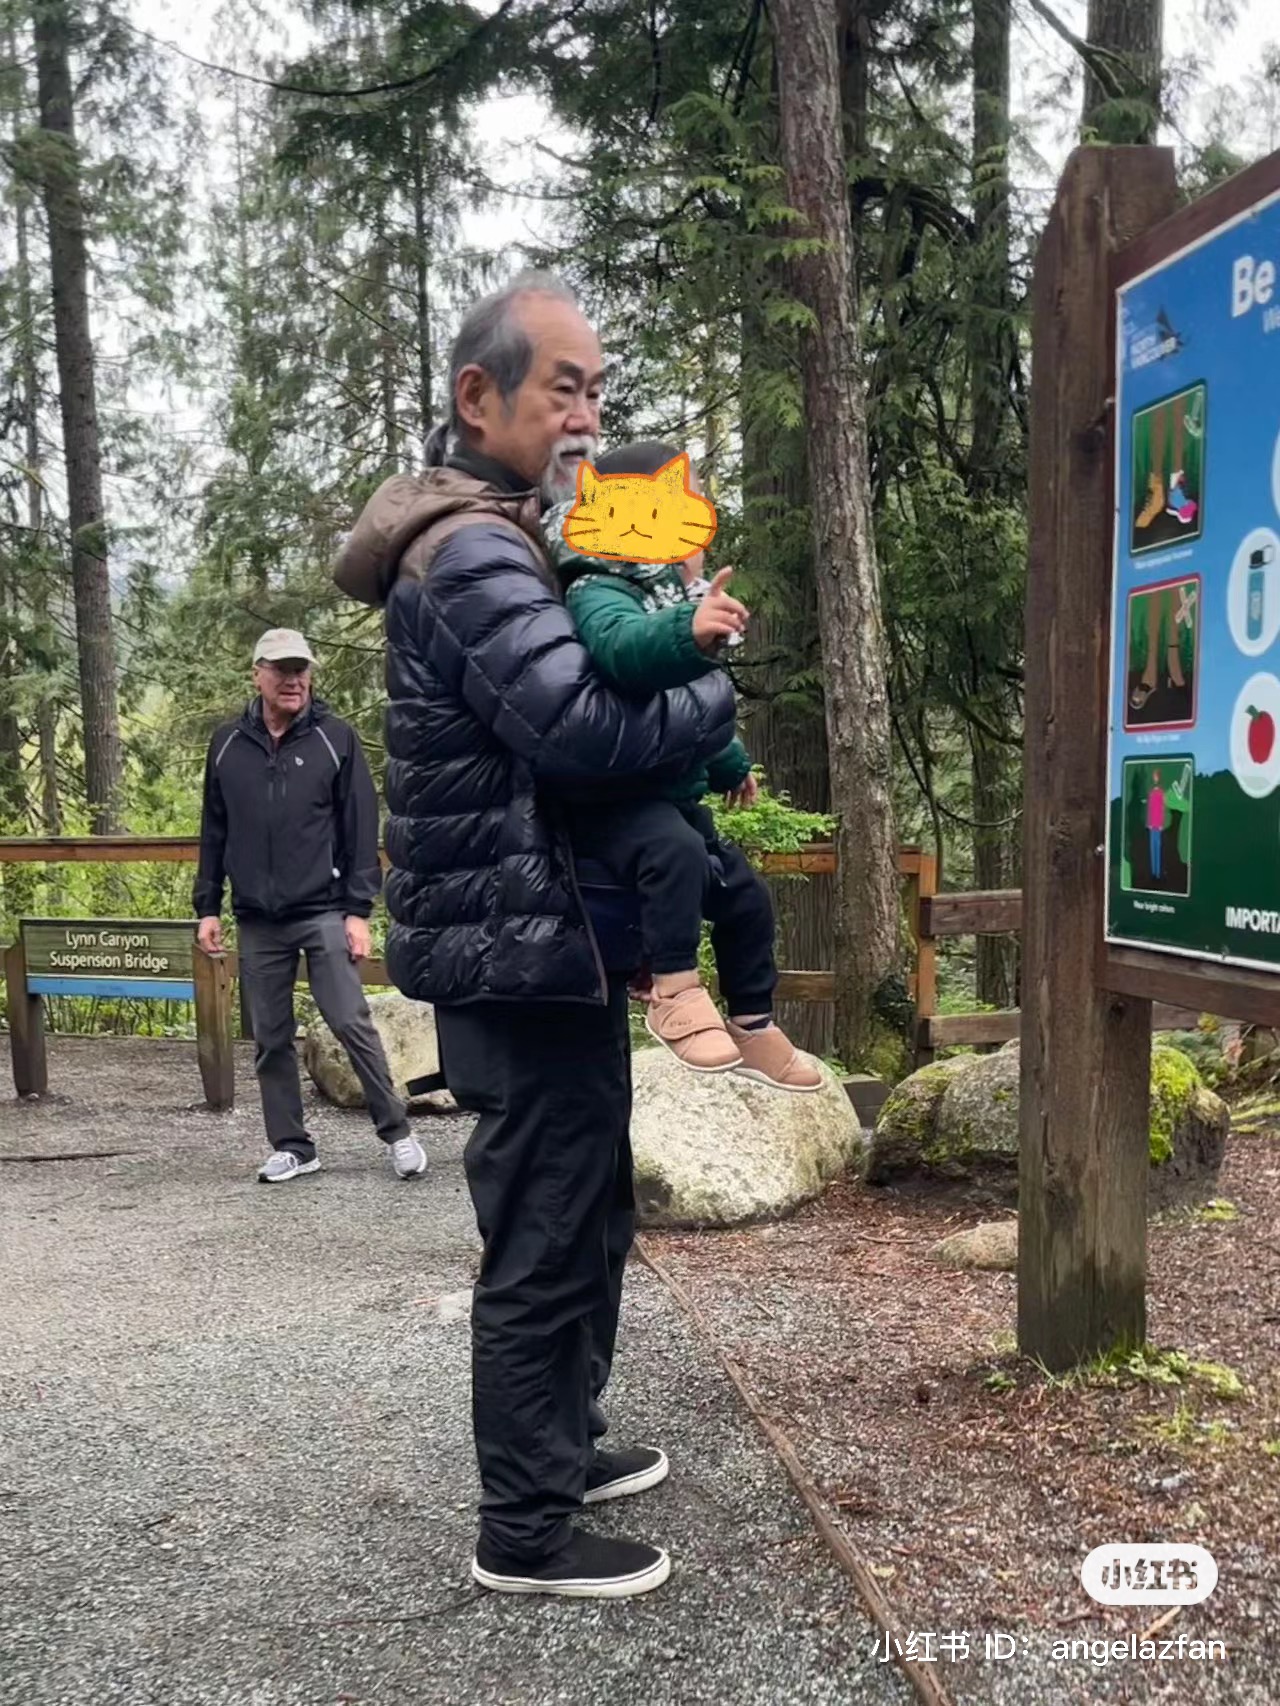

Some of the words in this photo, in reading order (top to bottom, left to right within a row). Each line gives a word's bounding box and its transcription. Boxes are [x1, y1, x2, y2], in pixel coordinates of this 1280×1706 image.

[1232, 255, 1275, 317] Be
[65, 930, 96, 949] Lynn
[100, 931, 149, 950] Canyon
[50, 951, 121, 971] Suspension
[125, 953, 168, 973] Bridge
